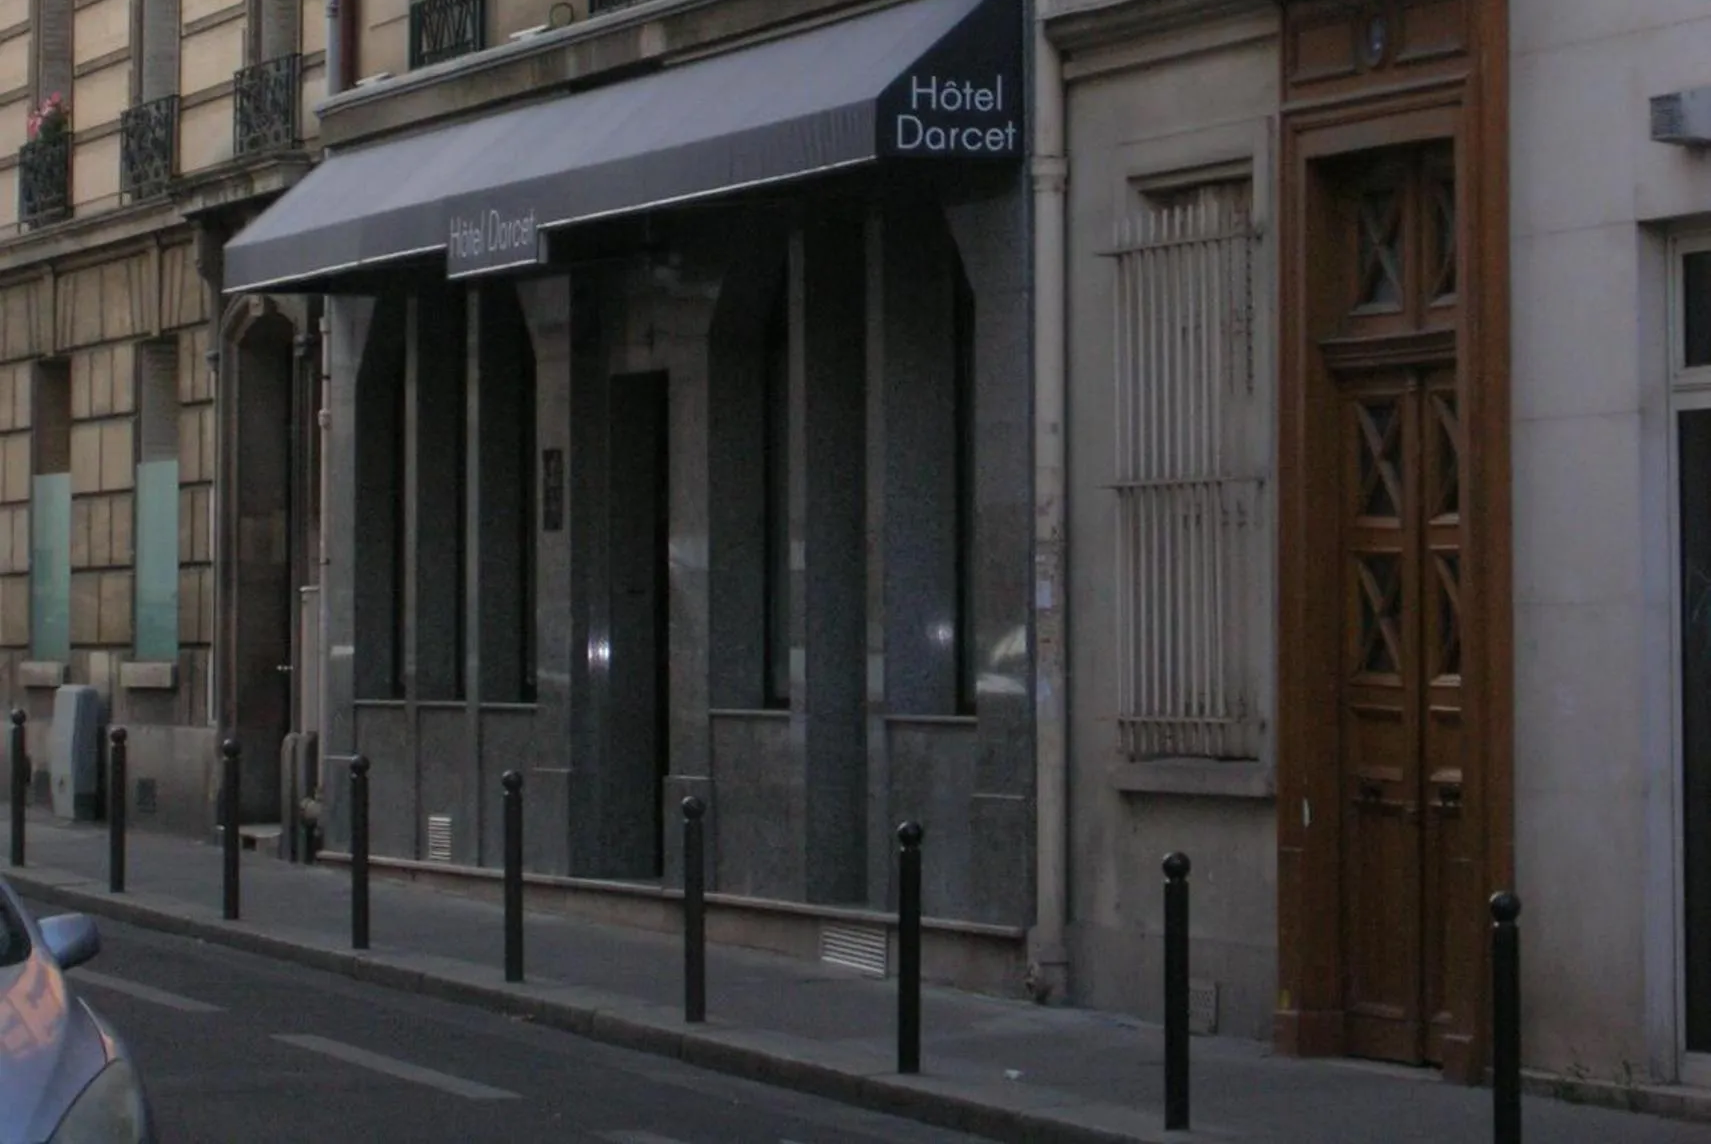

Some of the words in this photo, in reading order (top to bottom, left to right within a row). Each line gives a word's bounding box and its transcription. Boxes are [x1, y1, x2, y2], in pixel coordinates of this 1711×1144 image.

[911, 73, 1003, 111] Hôtel
[896, 114, 1018, 151] Darcet
[488, 207, 536, 251] Darcet
